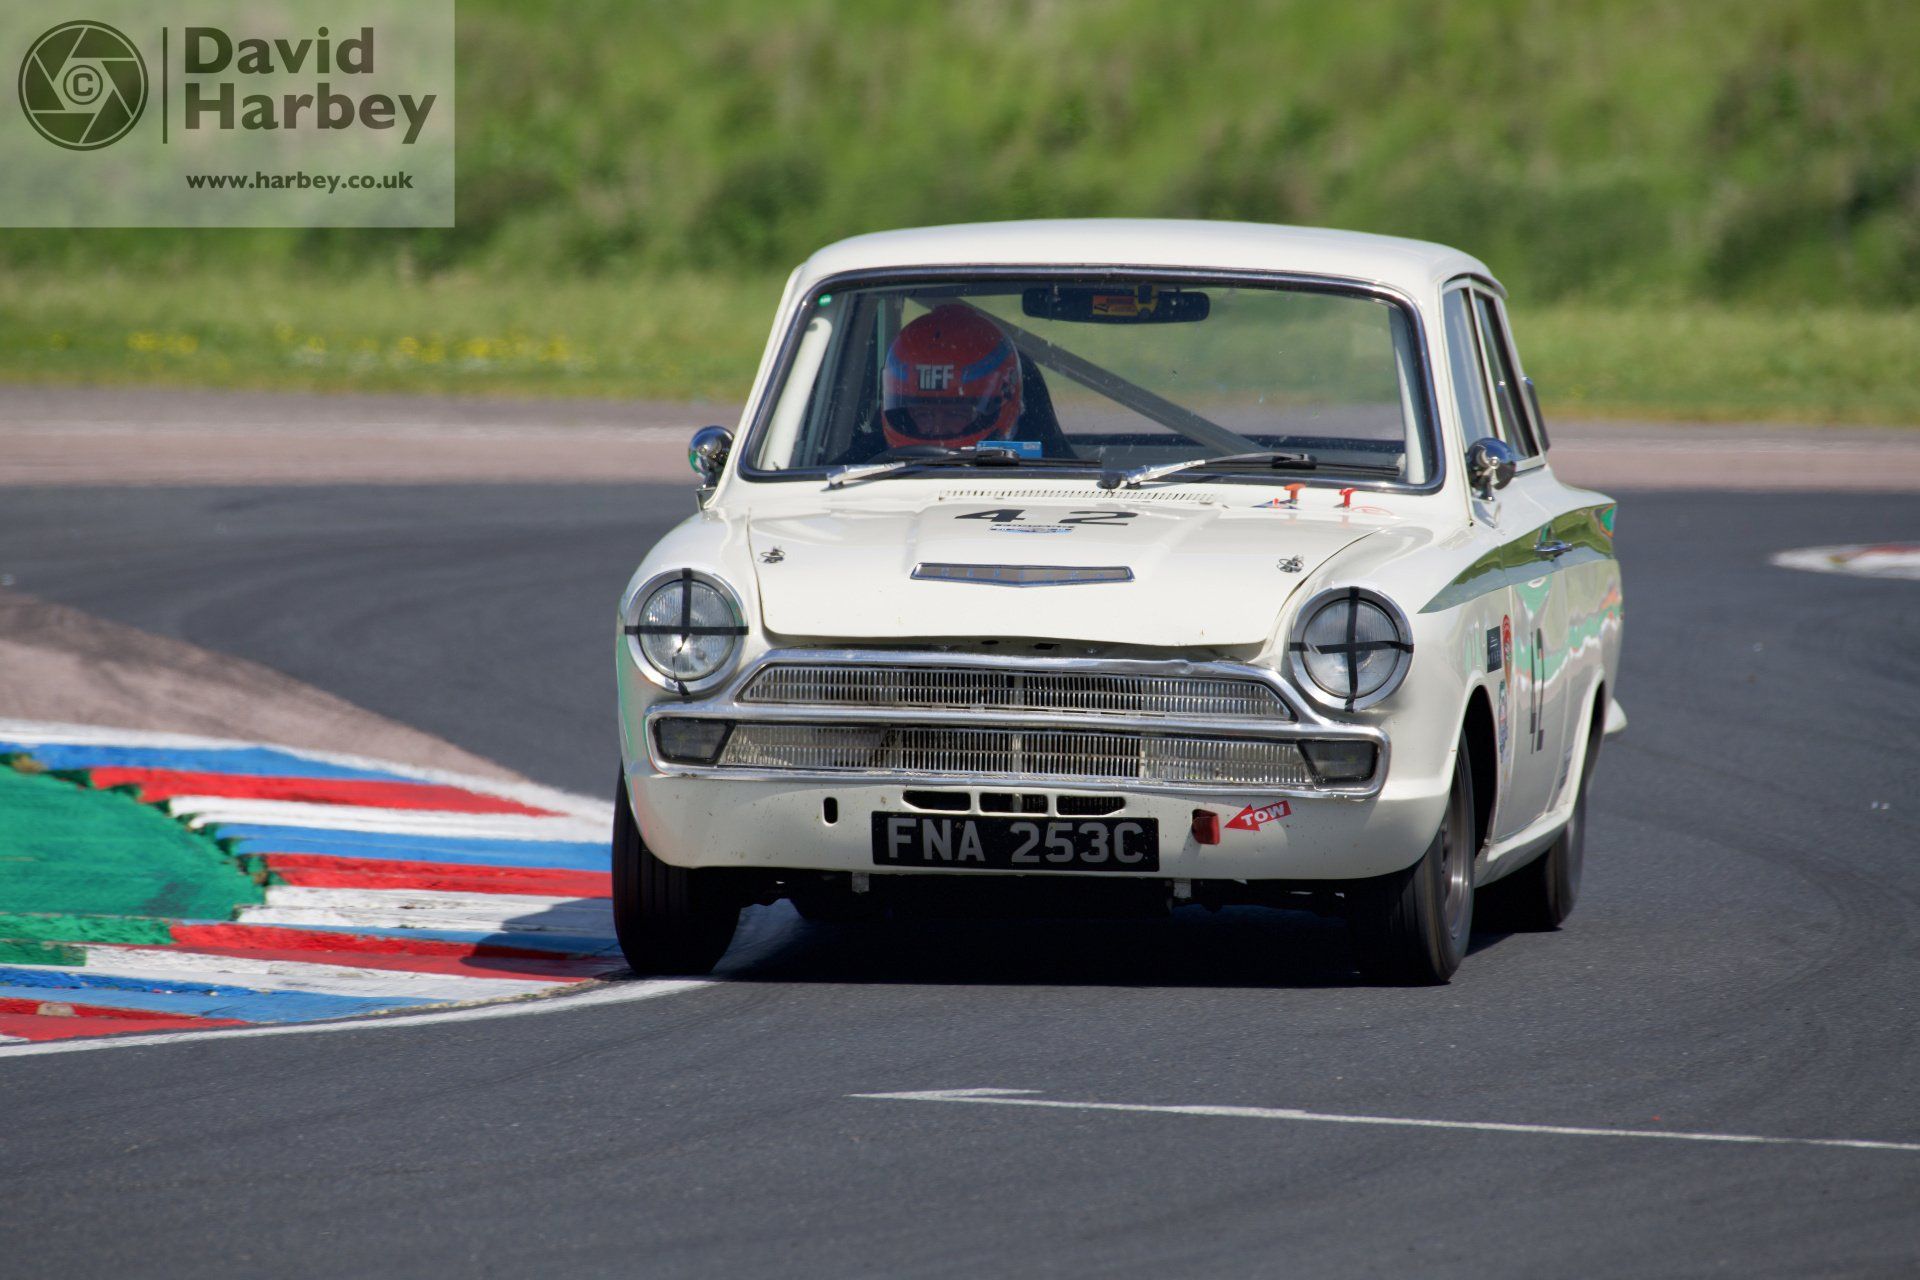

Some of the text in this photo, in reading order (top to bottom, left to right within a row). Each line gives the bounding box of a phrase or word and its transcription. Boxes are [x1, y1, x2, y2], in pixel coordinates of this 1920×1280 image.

[1240, 803, 1285, 826] TOW
[887, 817, 1145, 864] FNA 253C
